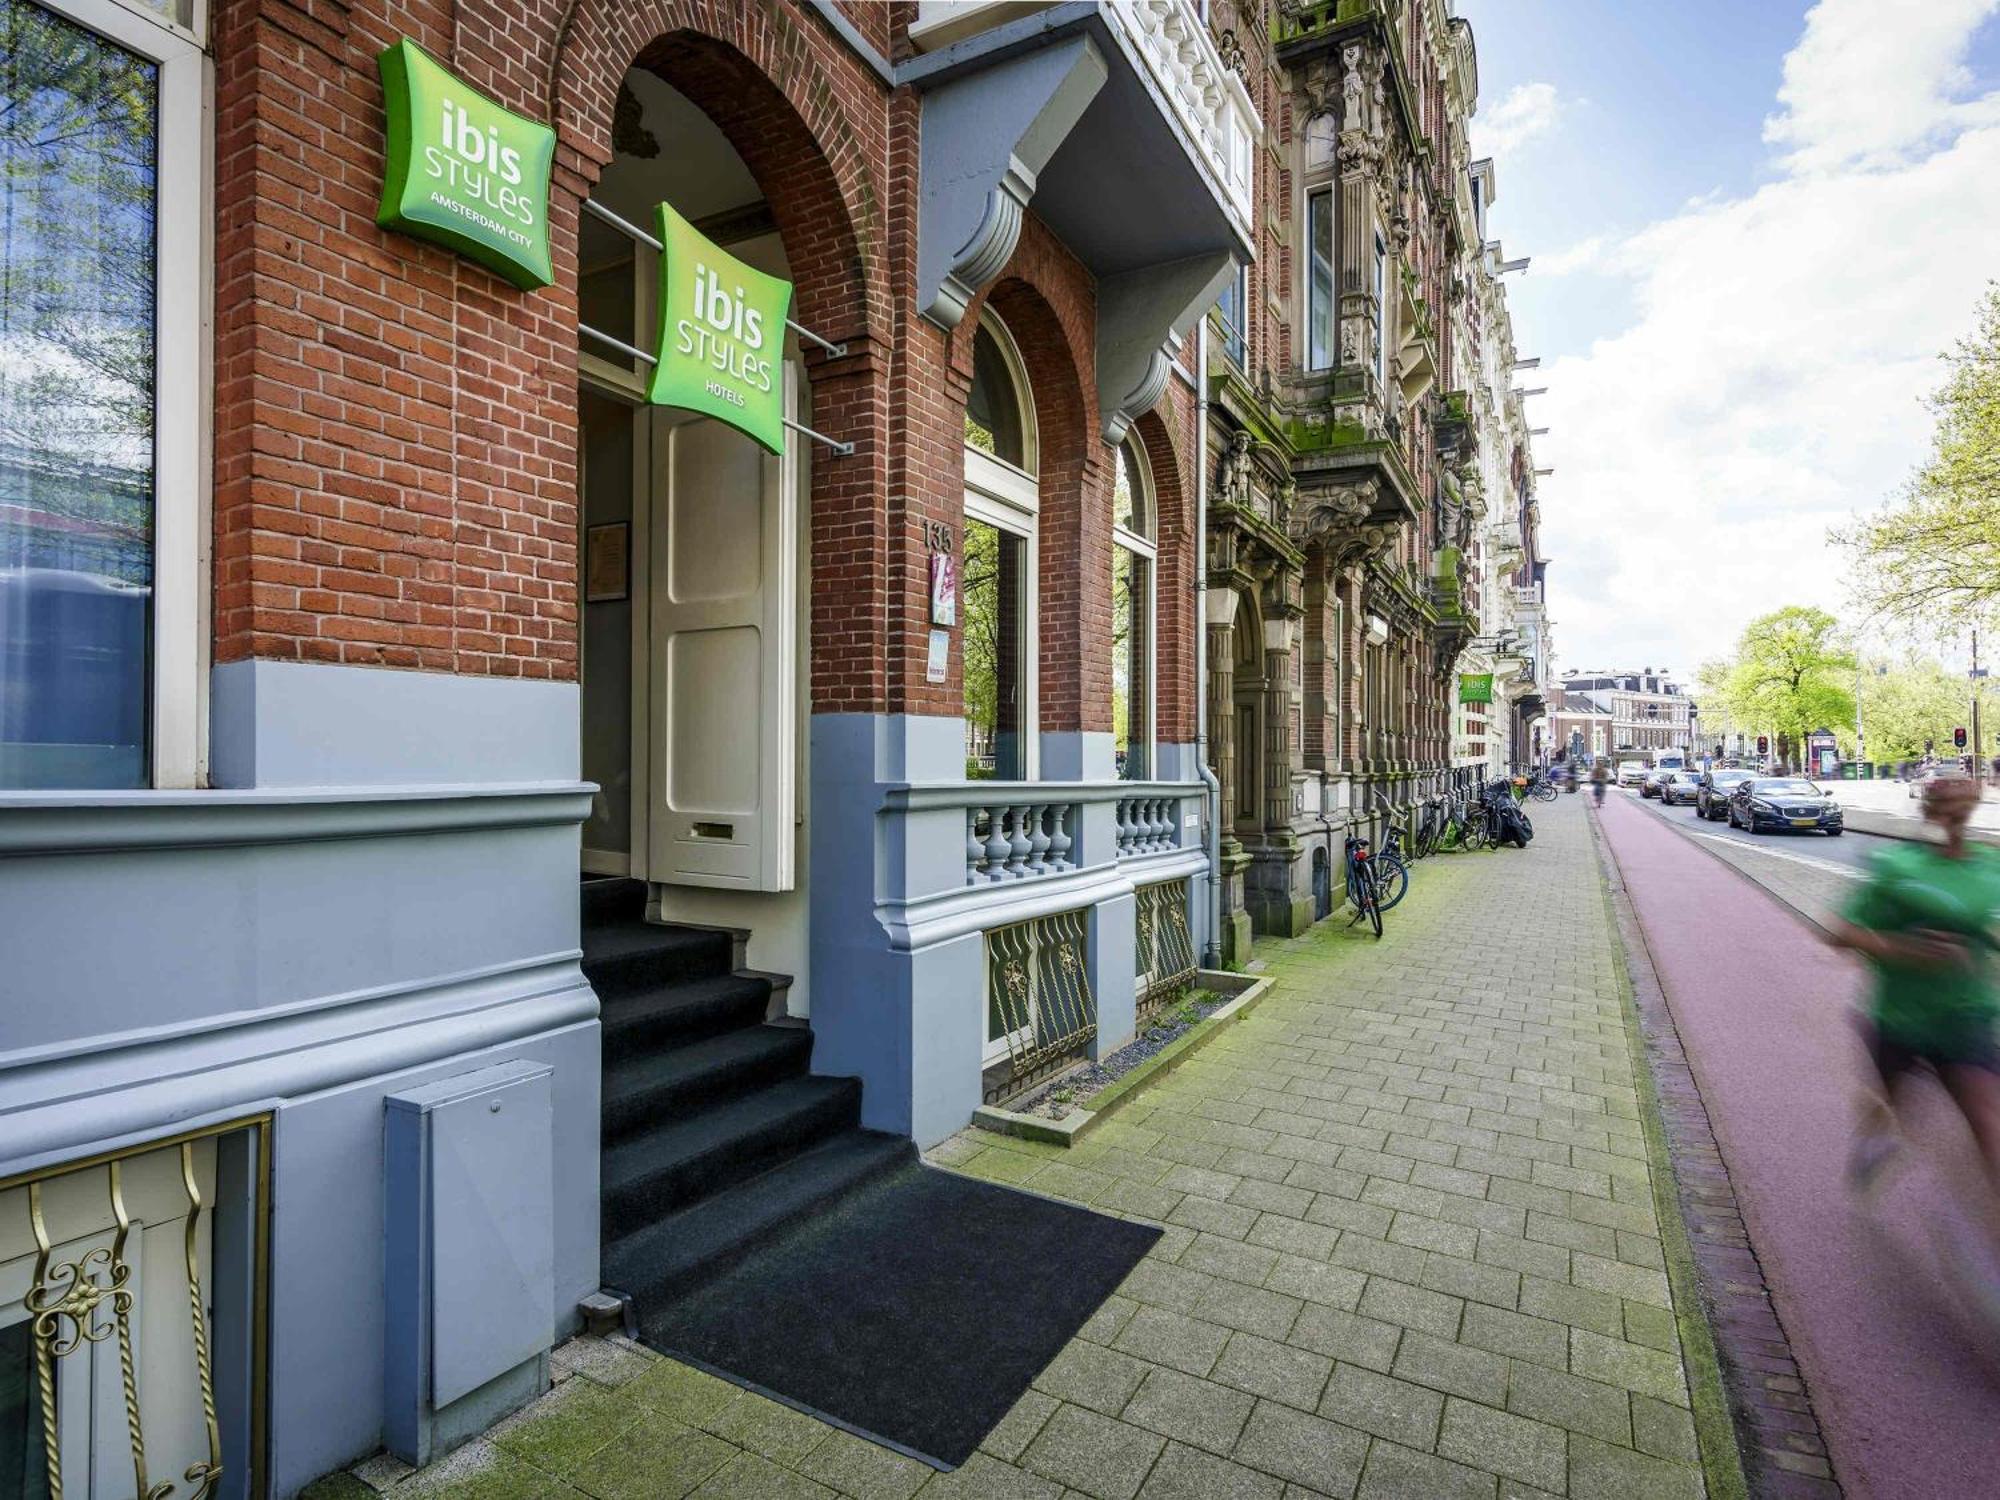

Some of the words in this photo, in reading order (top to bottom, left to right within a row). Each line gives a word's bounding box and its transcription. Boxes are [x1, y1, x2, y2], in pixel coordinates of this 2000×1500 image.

[442, 98, 522, 185] ibis
[430, 192, 507, 238] AMSTERDAM
[508, 230, 532, 249] CITY
[694, 263, 763, 348] ibis
[705, 379, 745, 407] HOTELS
[923, 519, 952, 553] 135
